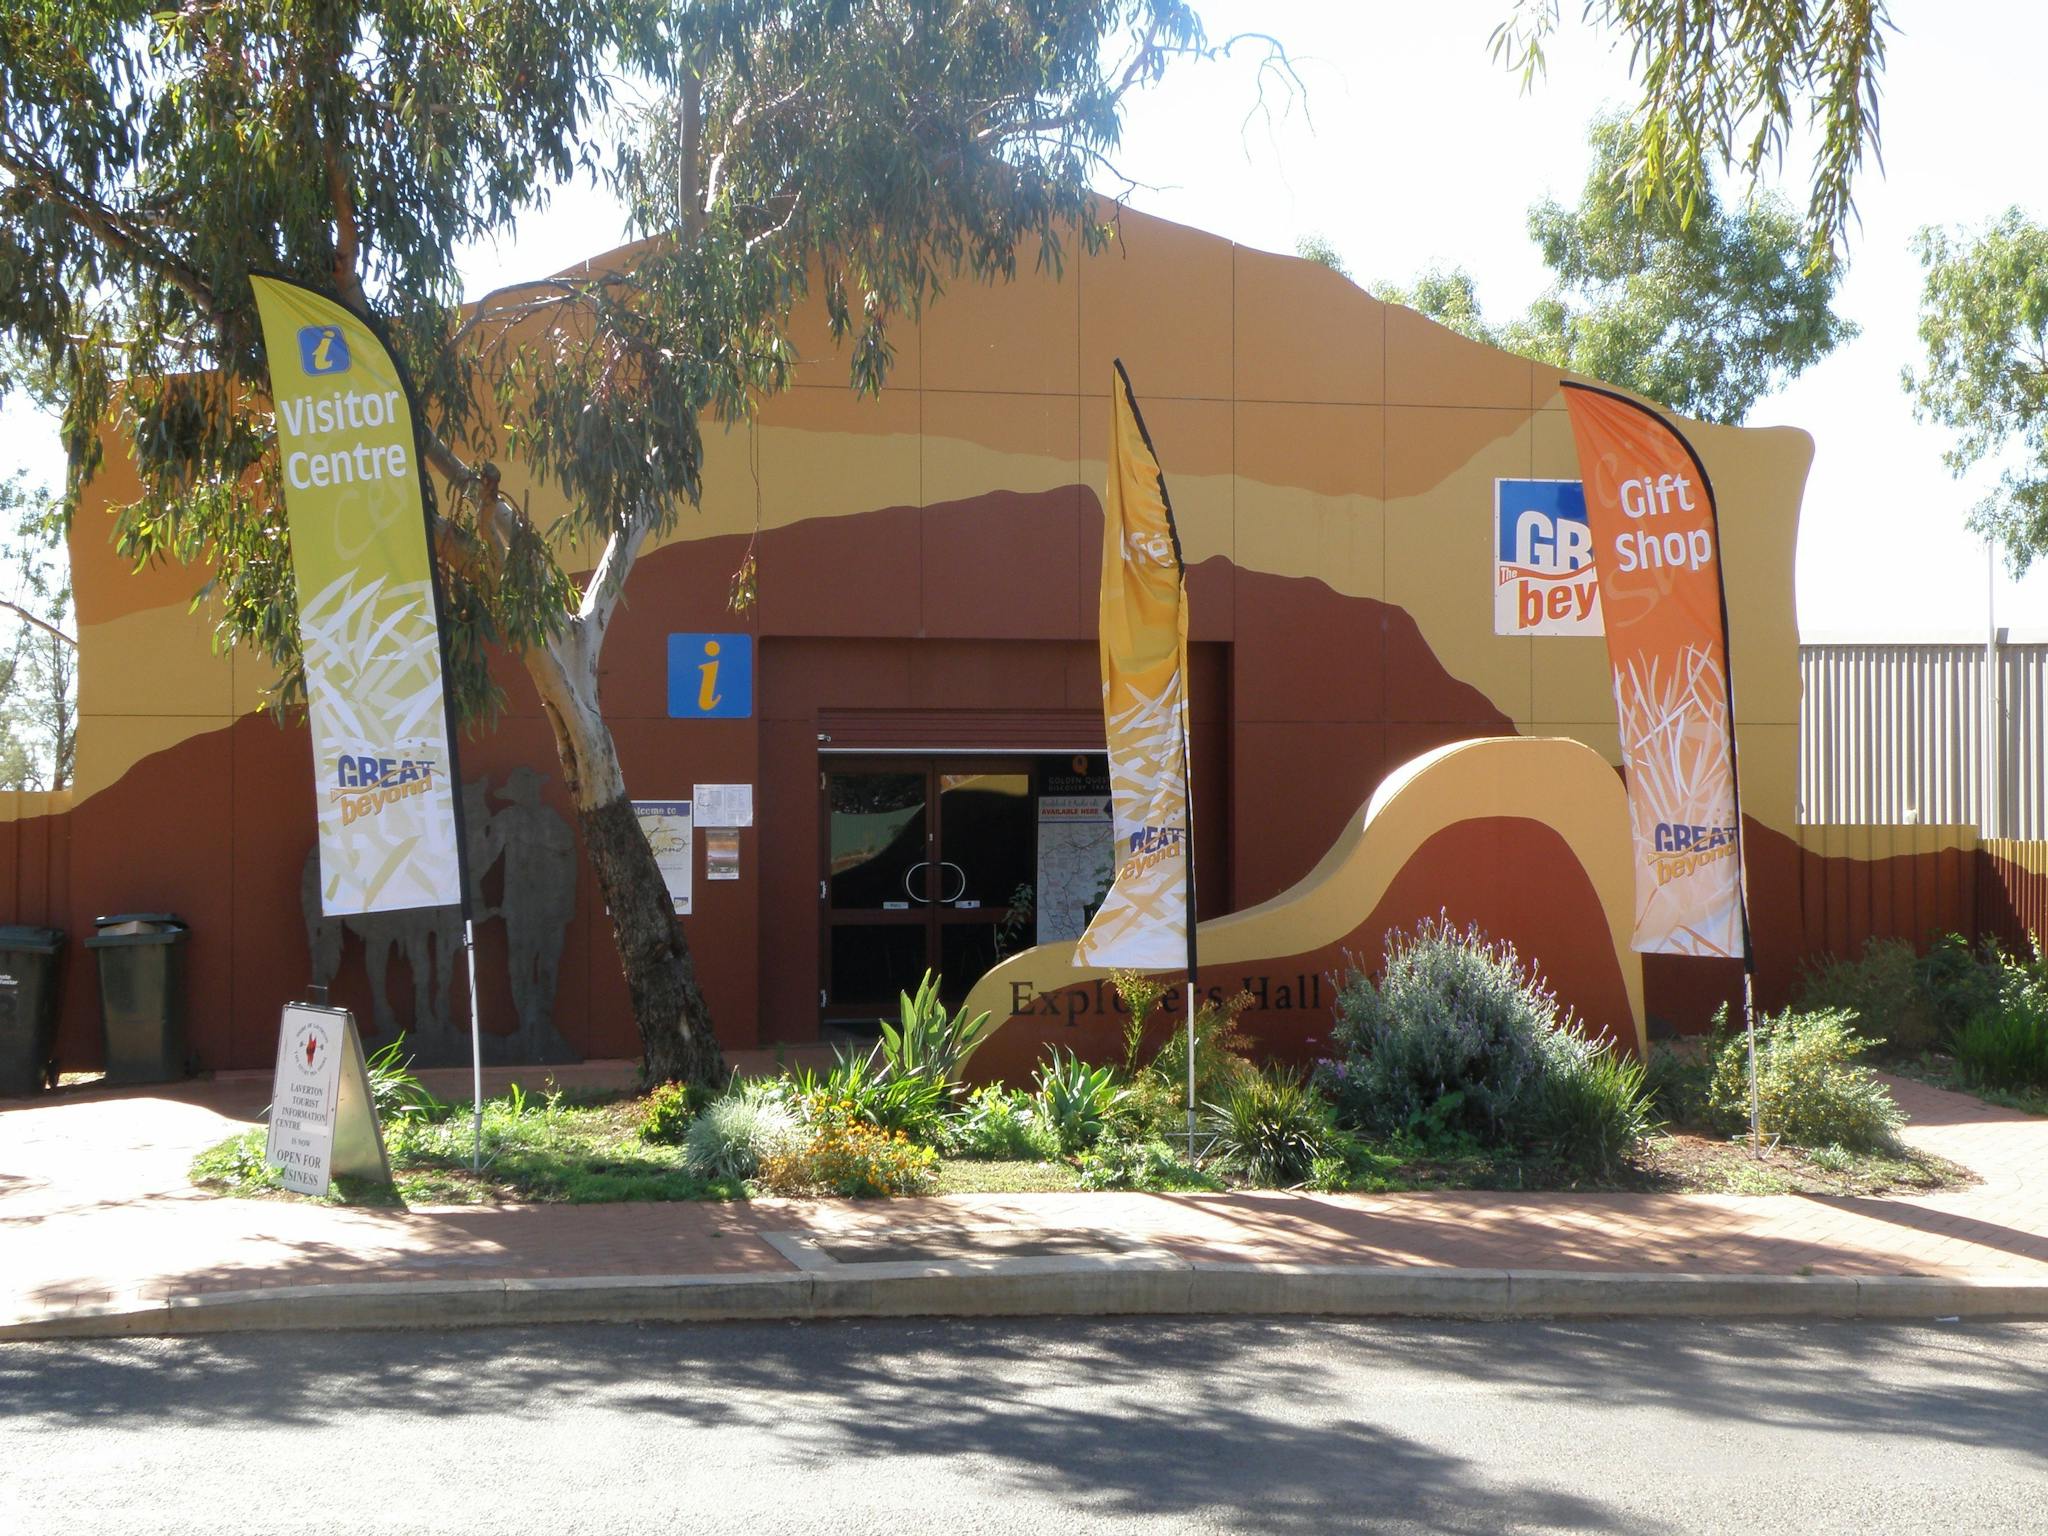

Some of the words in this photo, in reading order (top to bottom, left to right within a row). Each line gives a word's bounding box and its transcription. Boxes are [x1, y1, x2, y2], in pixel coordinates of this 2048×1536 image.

[280, 390, 399, 437] Visitor
[288, 442, 407, 490] Centre
[1620, 473, 1696, 519] Gift
[1615, 528, 1712, 573] Shop
[1501, 566, 1517, 582] The
[1518, 579, 1598, 630] bey
[338, 754, 435, 788] GREAT
[341, 775, 432, 826] beyond
[1655, 823, 1736, 852] GREAT
[1121, 841, 1180, 880] eyond
[1656, 842, 1736, 887] beyond
[1242, 974, 1320, 1011] Hall
[290, 1083, 323, 1097] LAVERTON
[293, 1095, 319, 1109] TOURIST
[276, 1118, 300, 1130] CENTRE
[282, 1107, 326, 1122] INFORMATION
[277, 1149, 300, 1164] OPEN
[303, 1154, 321, 1169] FOR
[283, 1166, 318, 1186] USINESS
